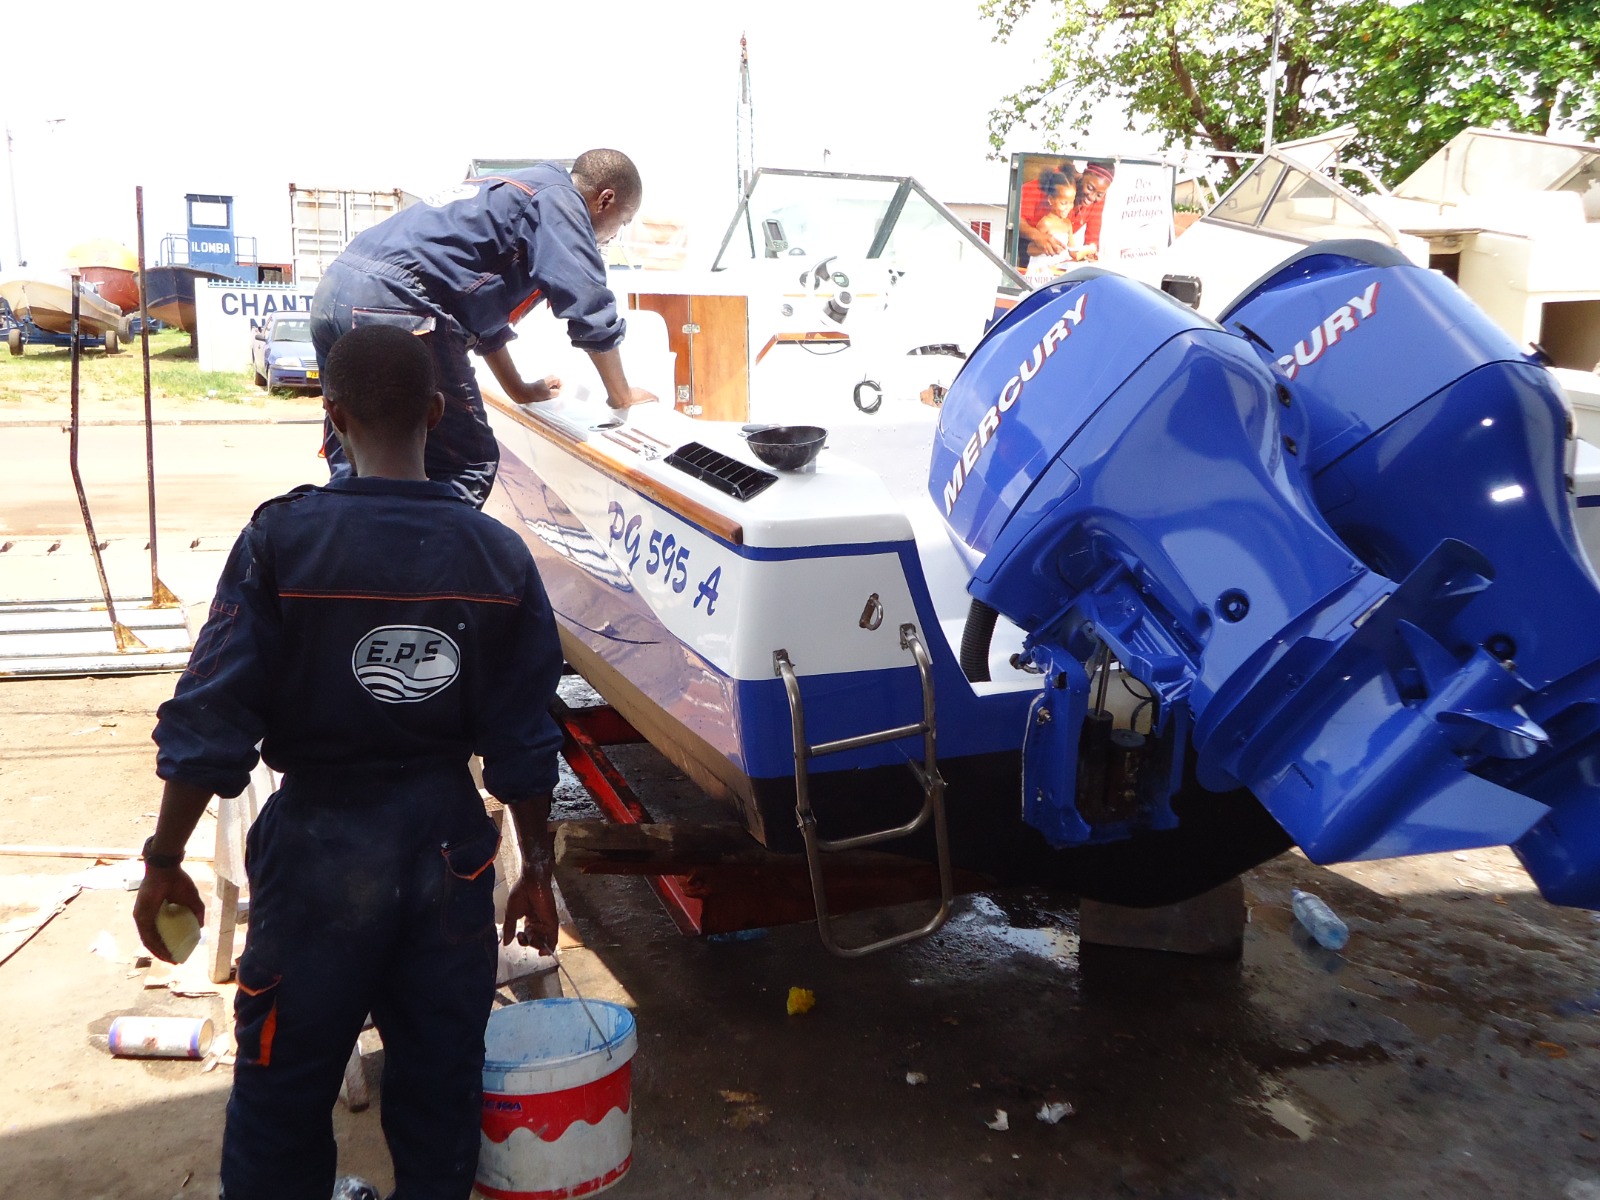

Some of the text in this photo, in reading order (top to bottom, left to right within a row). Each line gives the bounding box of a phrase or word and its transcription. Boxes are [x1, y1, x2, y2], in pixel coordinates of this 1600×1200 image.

[191, 241, 231, 254] ILOMBA
[943, 292, 1089, 518] MERCURY
[607, 500, 722, 616] PG 595 A
[366, 639, 443, 664] E.P.S
